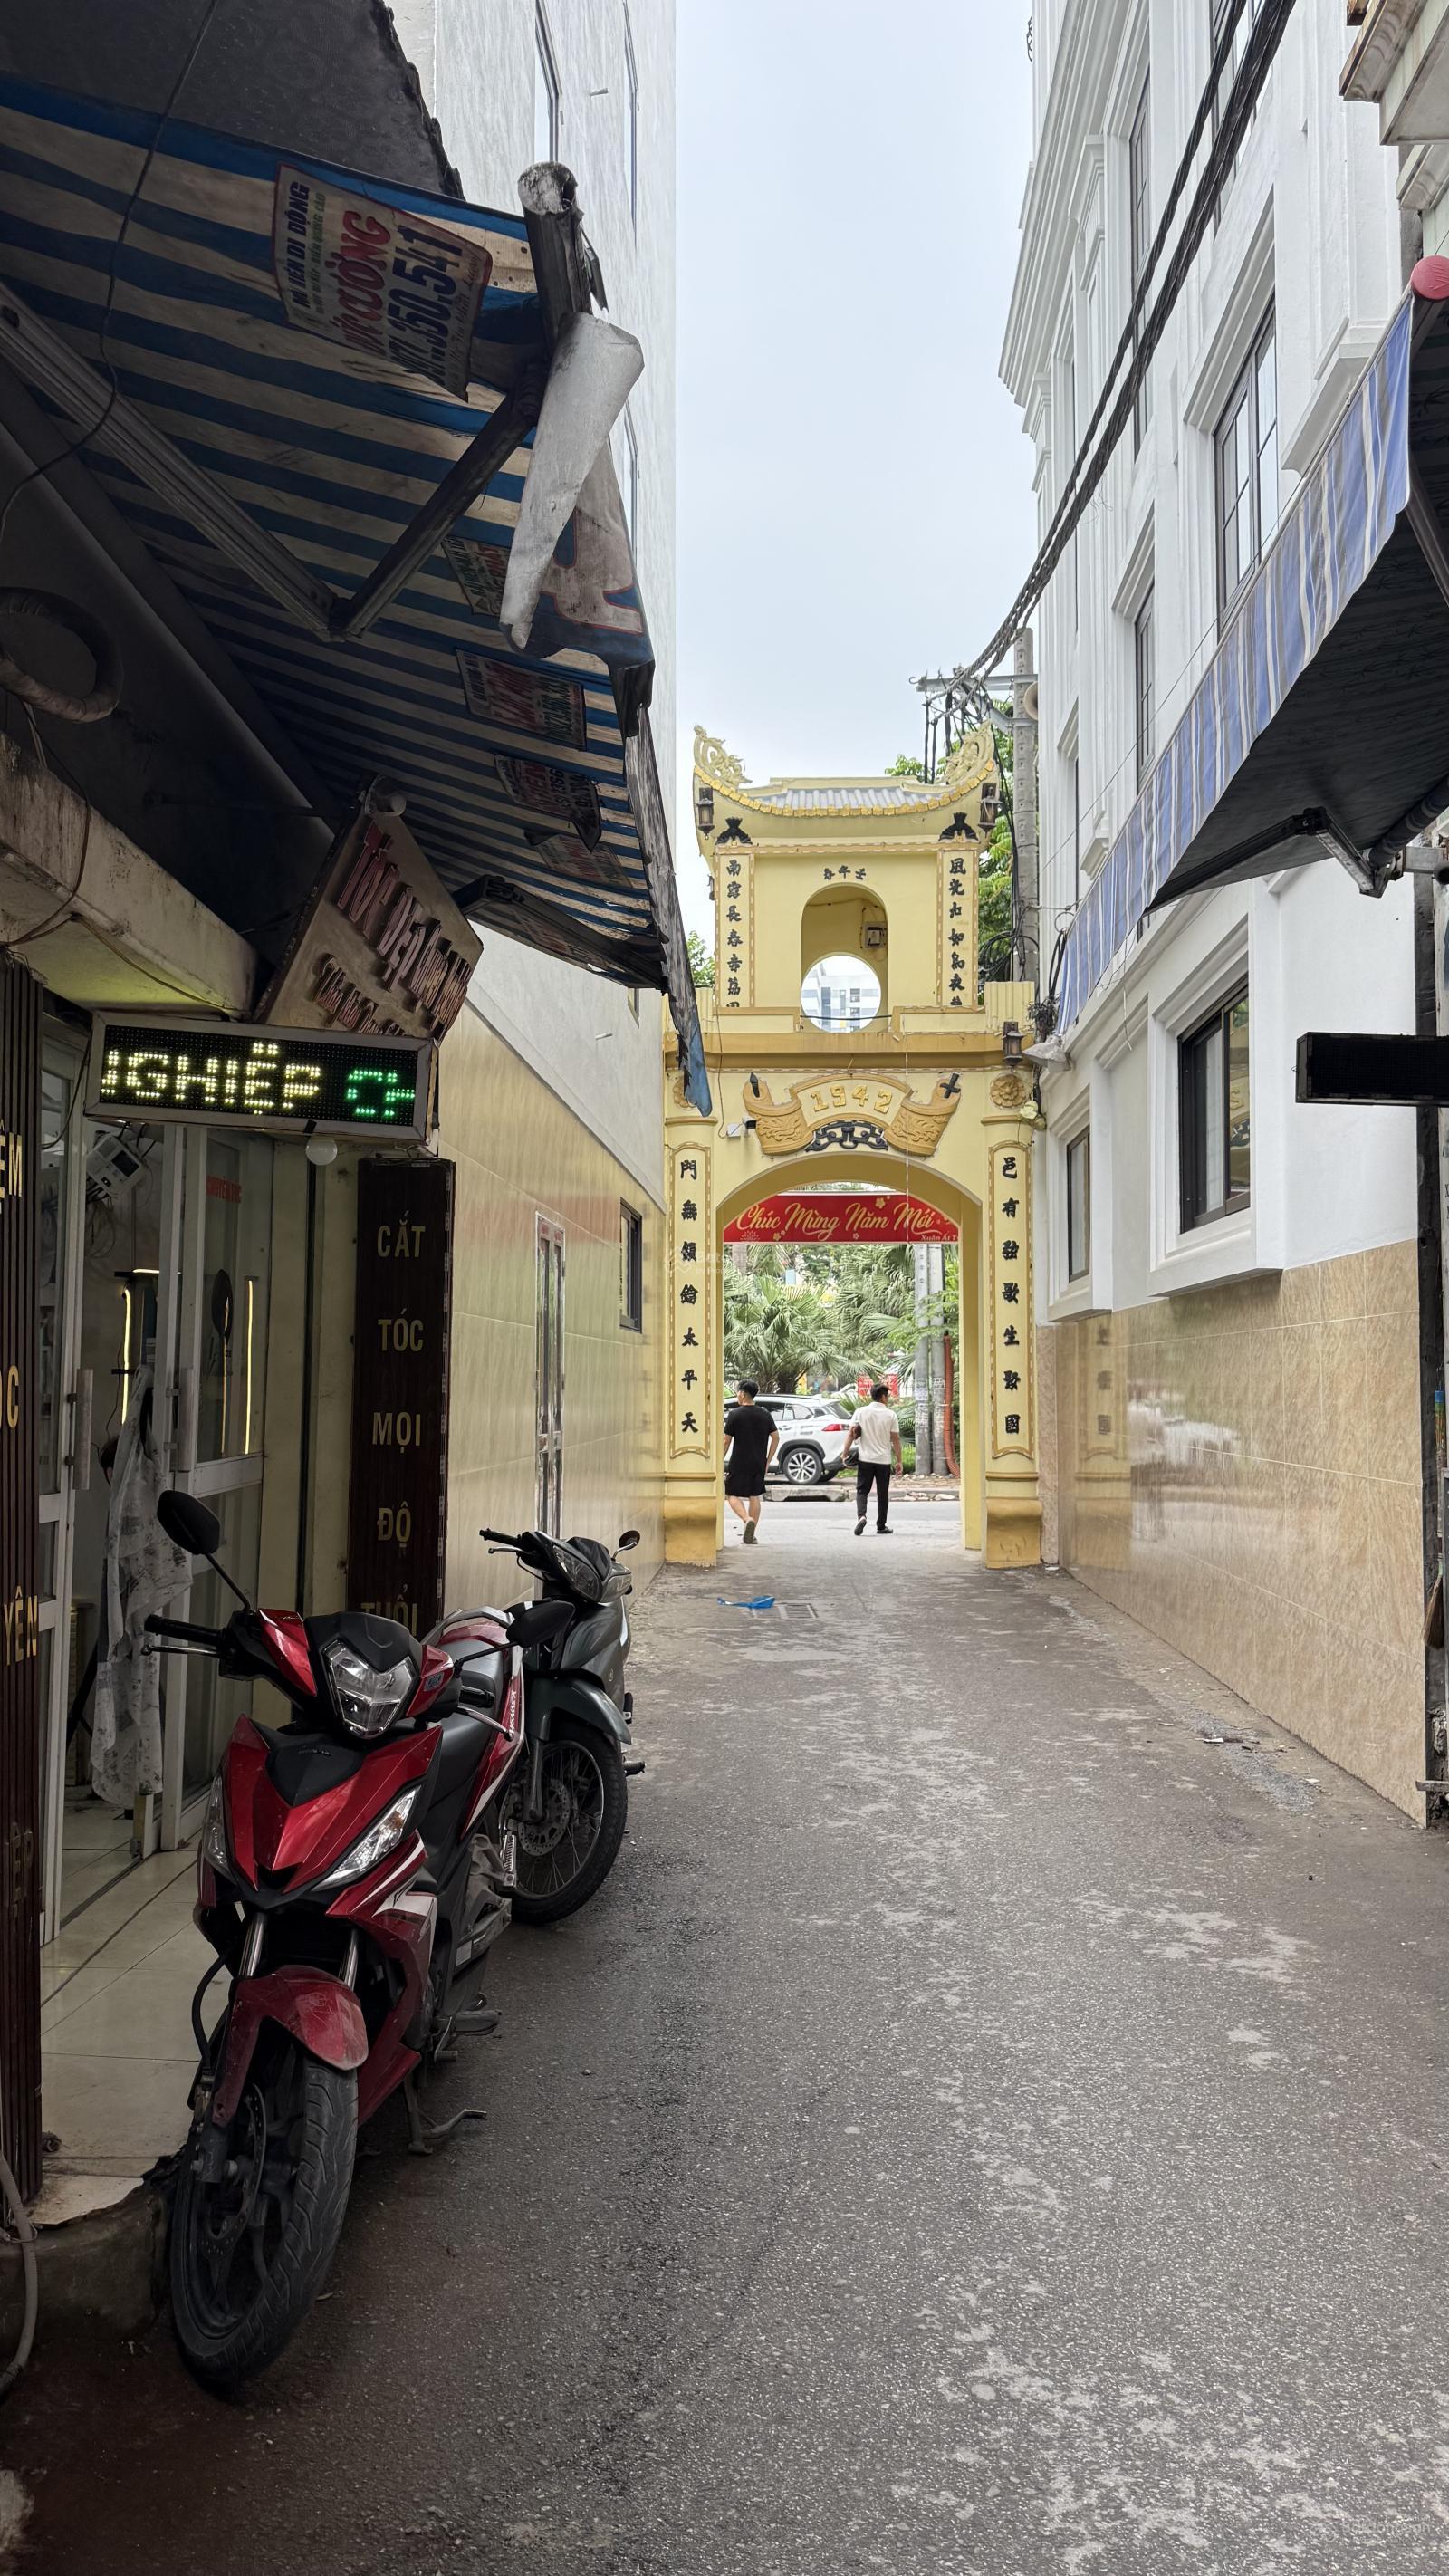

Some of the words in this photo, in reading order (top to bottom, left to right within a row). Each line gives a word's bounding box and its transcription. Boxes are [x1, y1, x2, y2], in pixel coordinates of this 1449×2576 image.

[284, 182, 310, 236] ĐỘNG
[286, 237, 306, 260] DI
[324, 210, 391, 321] CƯỜNG
[811, 1085, 893, 1114] 1942
[377, 1210, 426, 1258] CẮT
[736, 1203, 782, 1230] Chúc
[784, 1202, 841, 1241] Mừng
[845, 1202, 889, 1230] Năm
[893, 1202, 943, 1235] Mới
[377, 1308, 424, 1352] TÓC
[371, 1412, 421, 1454] MỌI
[377, 1500, 412, 1549] ĐỘ
